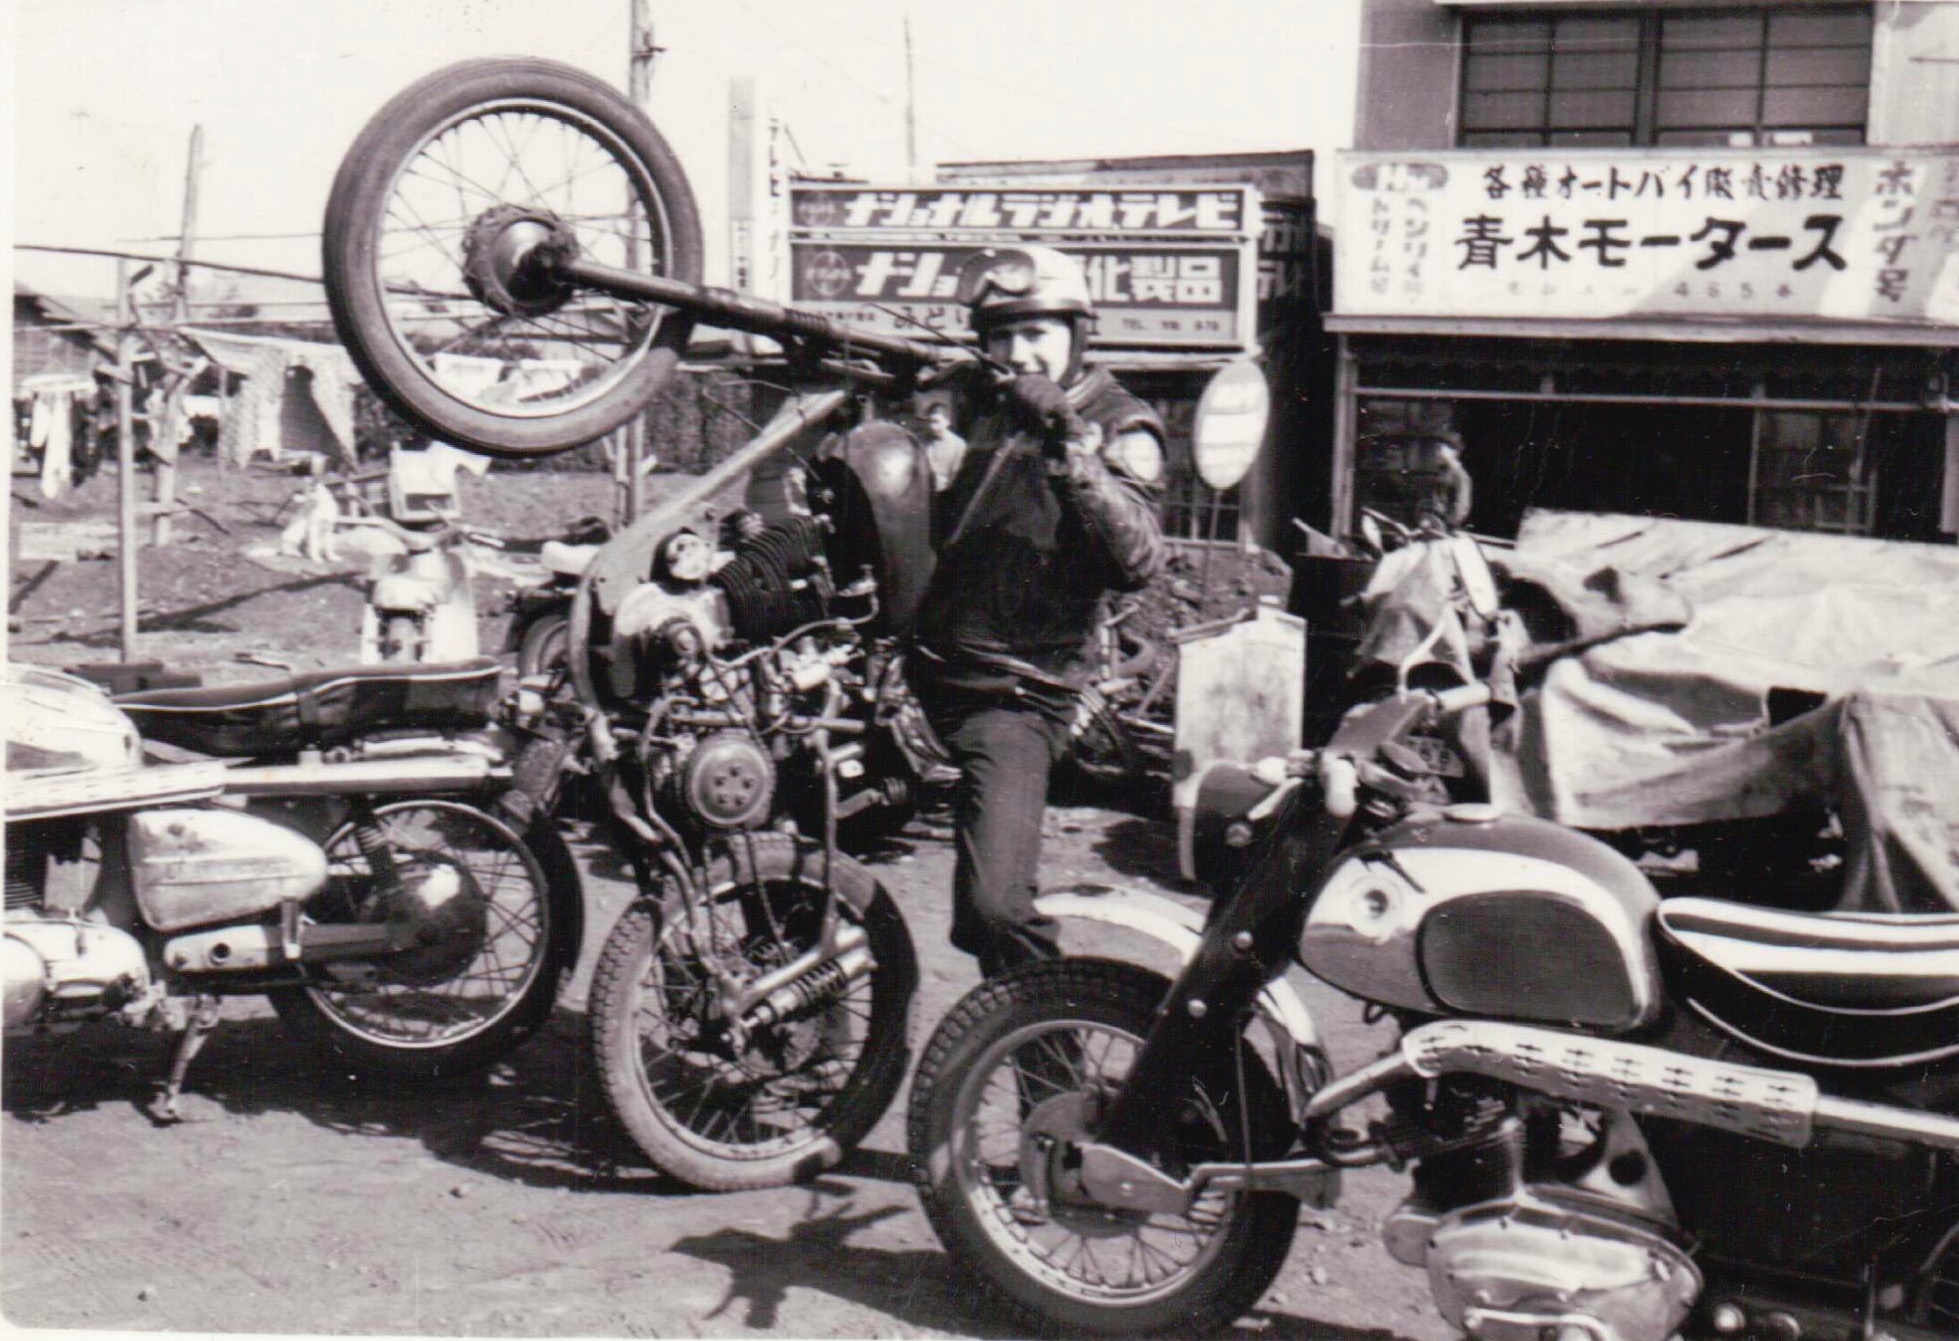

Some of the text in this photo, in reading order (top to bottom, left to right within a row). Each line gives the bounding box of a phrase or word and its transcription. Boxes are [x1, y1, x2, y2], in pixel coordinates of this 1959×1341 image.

[844, 192, 1237, 227] ナショナルラジオテレビ
[1454, 215, 1847, 270] 青木モータース
